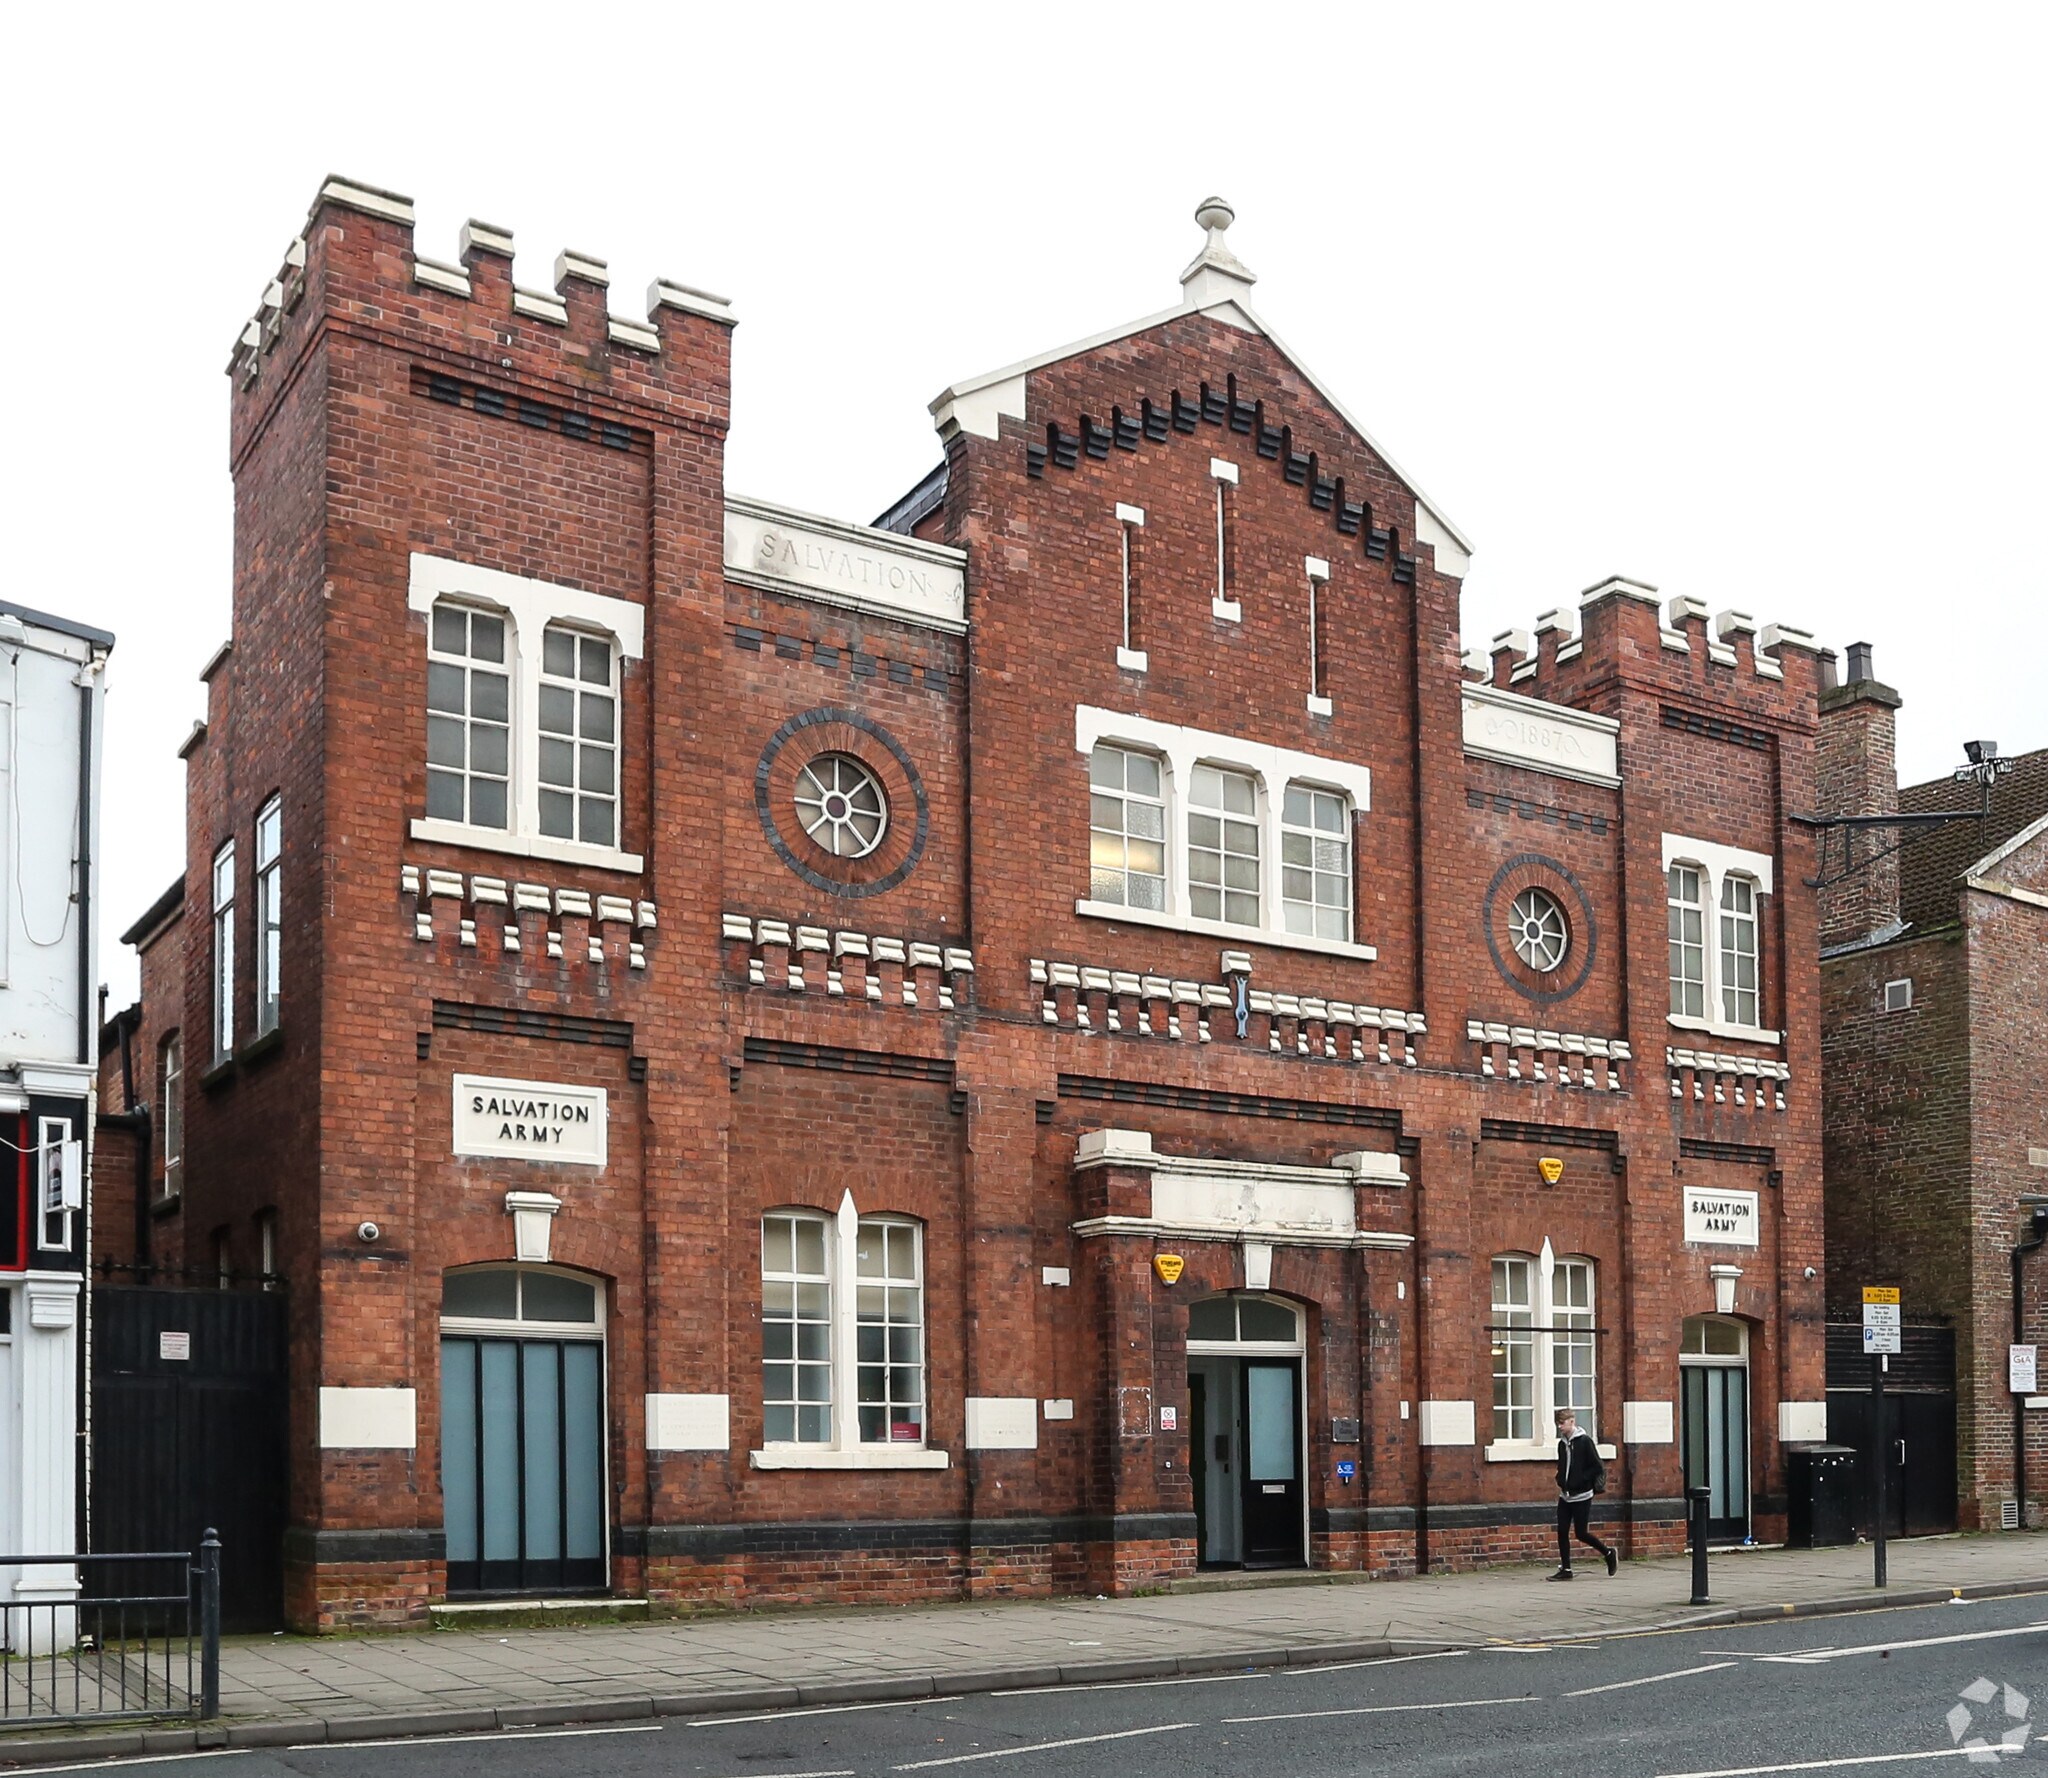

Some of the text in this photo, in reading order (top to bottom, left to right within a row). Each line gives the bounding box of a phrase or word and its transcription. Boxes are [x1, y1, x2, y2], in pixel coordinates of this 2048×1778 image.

[760, 533, 928, 597] SALVATION
[1521, 722, 1562, 749] 1887
[472, 1096, 589, 1123] SALVATION
[498, 1122, 563, 1144] ARMY
[1692, 1200, 1749, 1217] SALVATION
[1704, 1218, 1737, 1232] ARMY
